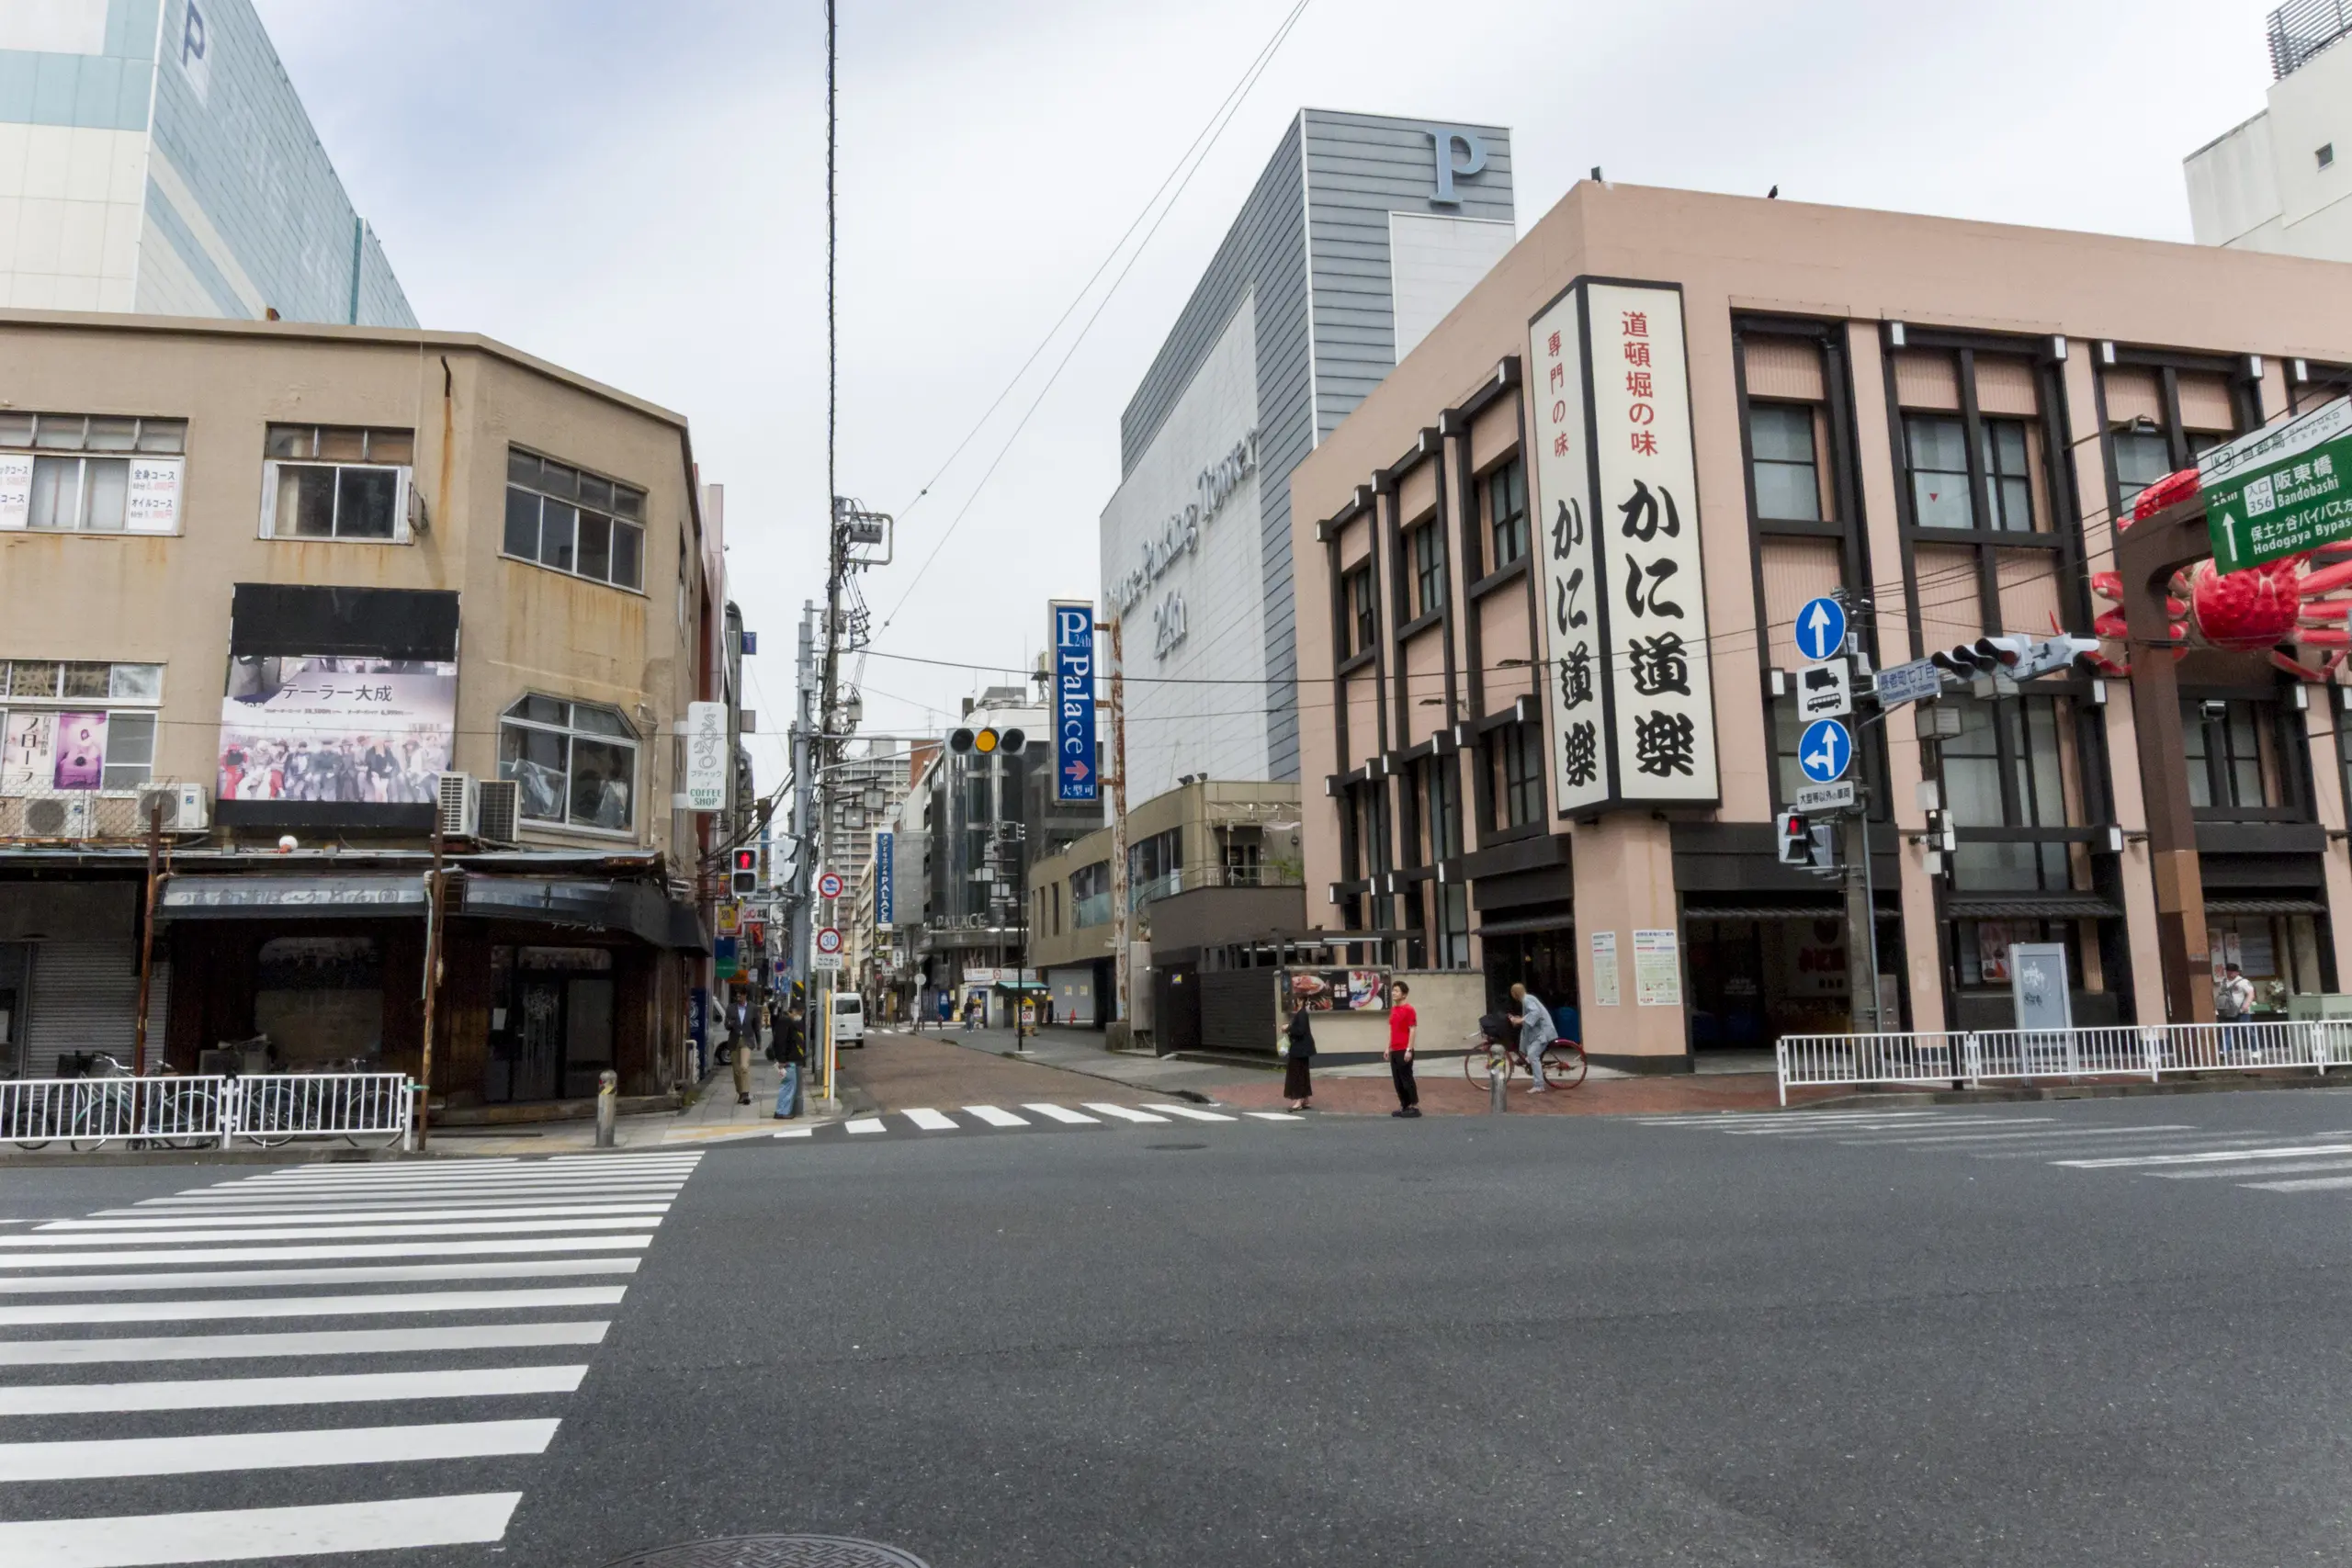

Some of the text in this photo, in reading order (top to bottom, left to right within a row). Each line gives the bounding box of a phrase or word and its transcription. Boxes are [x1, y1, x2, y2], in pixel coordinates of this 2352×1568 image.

[1426, 129, 1488, 203] P
[1621, 310, 1659, 457] 道頓堀の味
[133, 468, 175, 480] 全身コース
[2274, 455, 2334, 491] 阪東橋
[2247, 481, 2269, 497] 入口
[2278, 475, 2339, 507] Bandobashi
[131, 498, 173, 508] オイルコース
[2249, 496, 2272, 513] 356
[2254, 516, 2352, 555] Hodogaya Bypas
[1058, 612, 1088, 647] P
[282, 683, 392, 702] テーラー大成
[1062, 654, 1091, 754] Palace
[690, 789, 721, 797] COFFEE
[1062, 784, 1094, 795] 大型可
[695, 797, 718, 806] SHOP
[880, 876, 889, 923] PALACE
[936, 913, 987, 931] PALACE
[822, 935, 837, 947] 30
[817, 957, 840, 967] ここから
